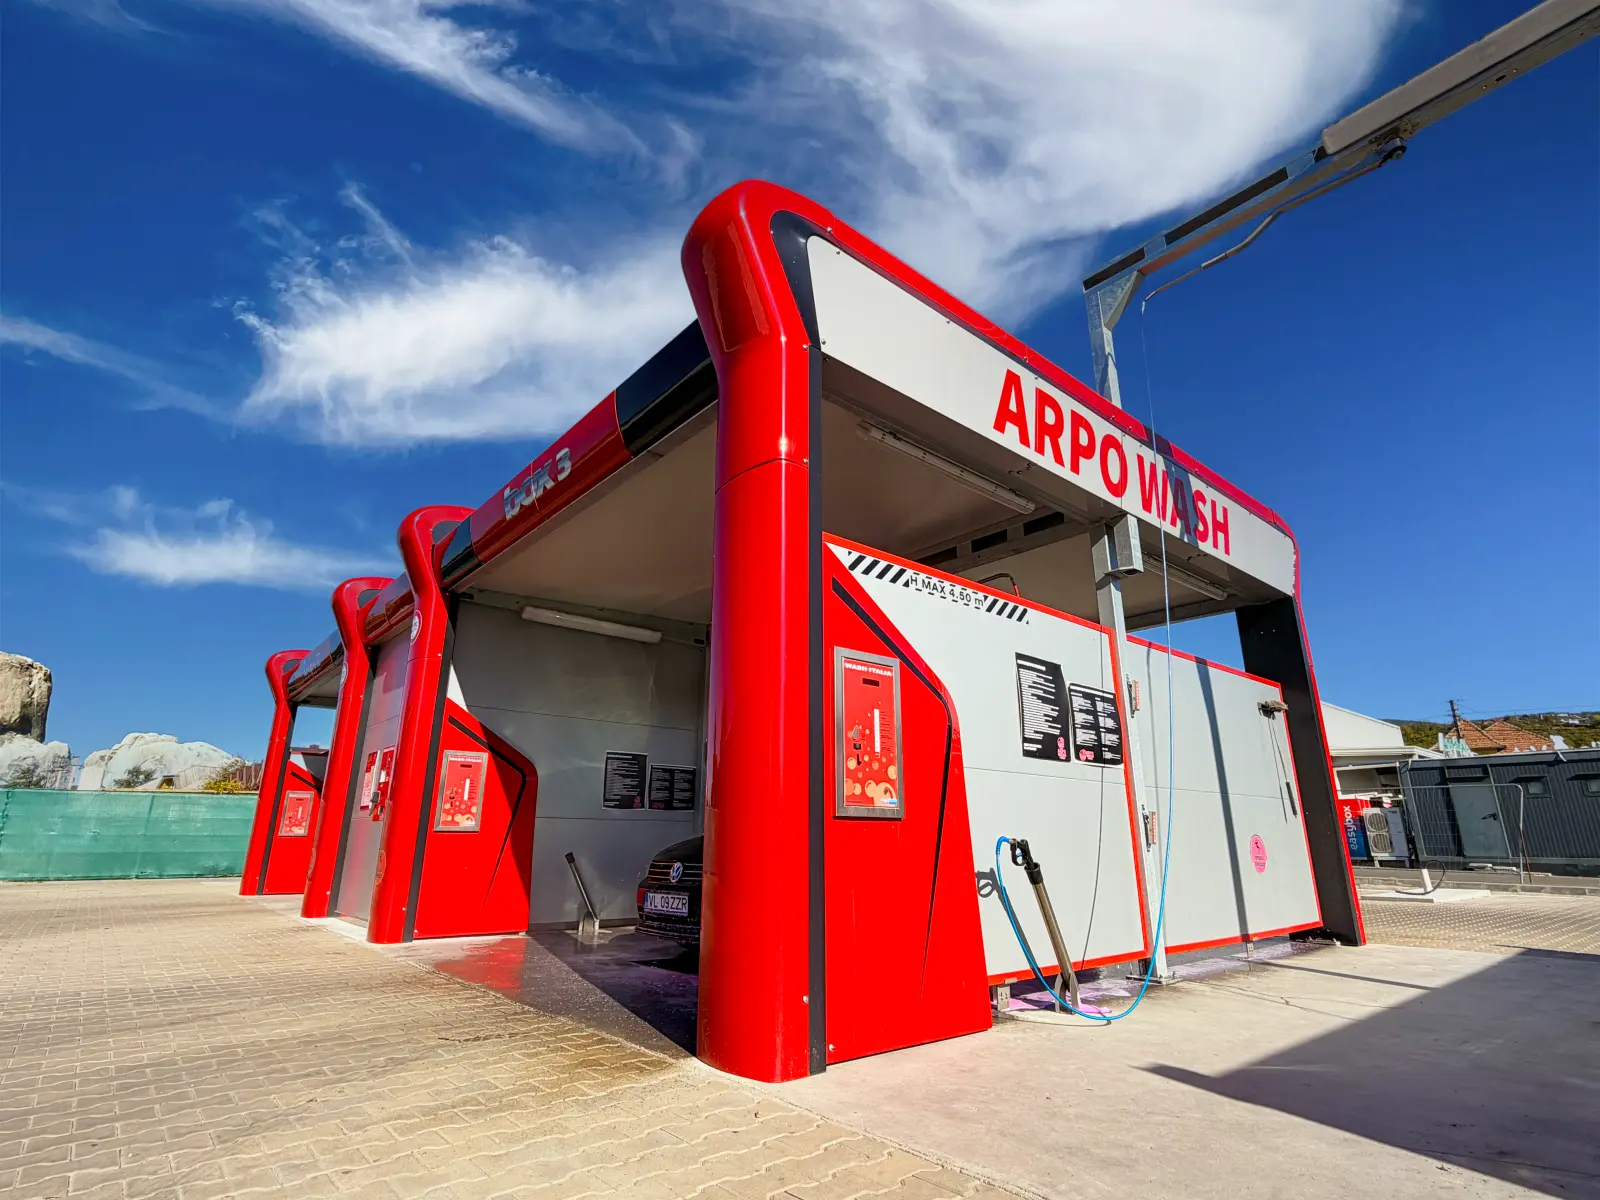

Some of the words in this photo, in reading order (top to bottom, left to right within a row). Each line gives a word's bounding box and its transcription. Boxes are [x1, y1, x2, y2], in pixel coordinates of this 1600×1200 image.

[504, 458, 556, 521] box
[556, 447, 572, 481] 3
[993, 368, 1129, 499] ARPO
[1136, 452, 1231, 557] WASH
[910, 575, 918, 587] H
[922, 579, 946, 595] MAX
[949, 589, 972, 603] 4.50
[974, 597, 984, 607] m
[844, 662, 868, 672] WASH
[868, 667, 893, 677] ITALIA
[1343, 805, 1358, 850] easybox
